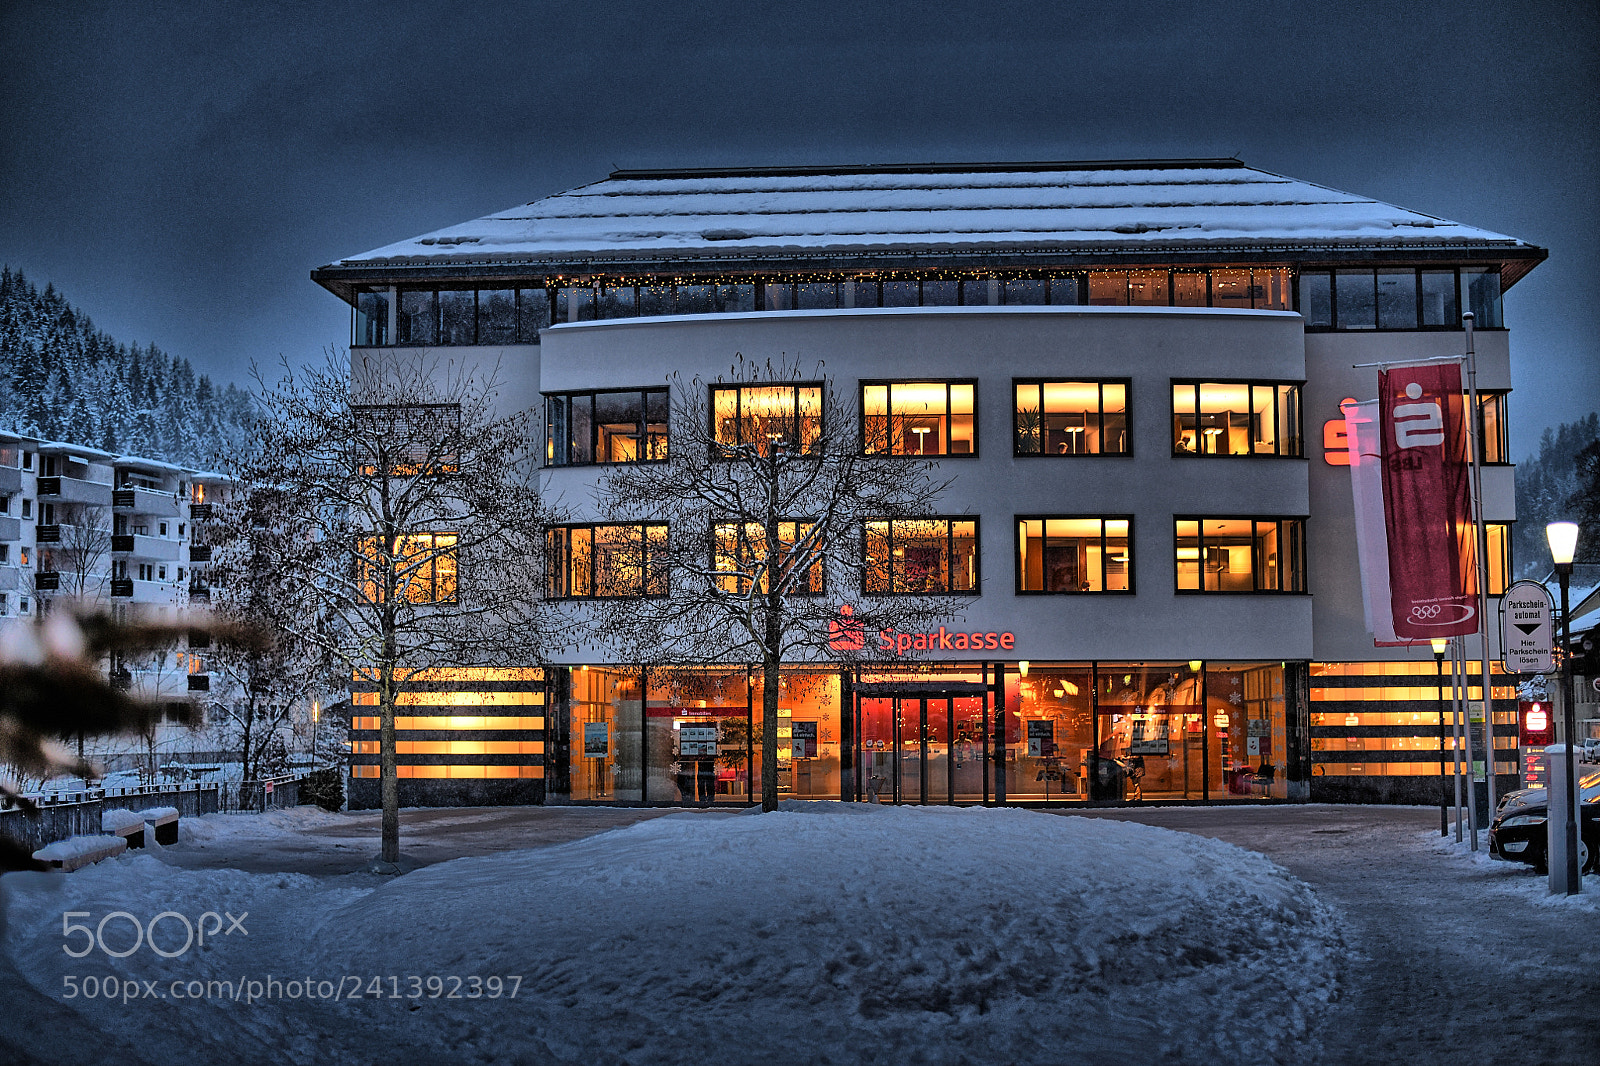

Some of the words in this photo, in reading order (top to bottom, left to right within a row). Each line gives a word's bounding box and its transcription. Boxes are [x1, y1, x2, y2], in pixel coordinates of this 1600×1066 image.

[1508, 600, 1547, 609] Parkschein-
[1514, 611, 1541, 619] automat
[880, 626, 1015, 656] Sparkasse
[1519, 656, 1539, 664] lösen
